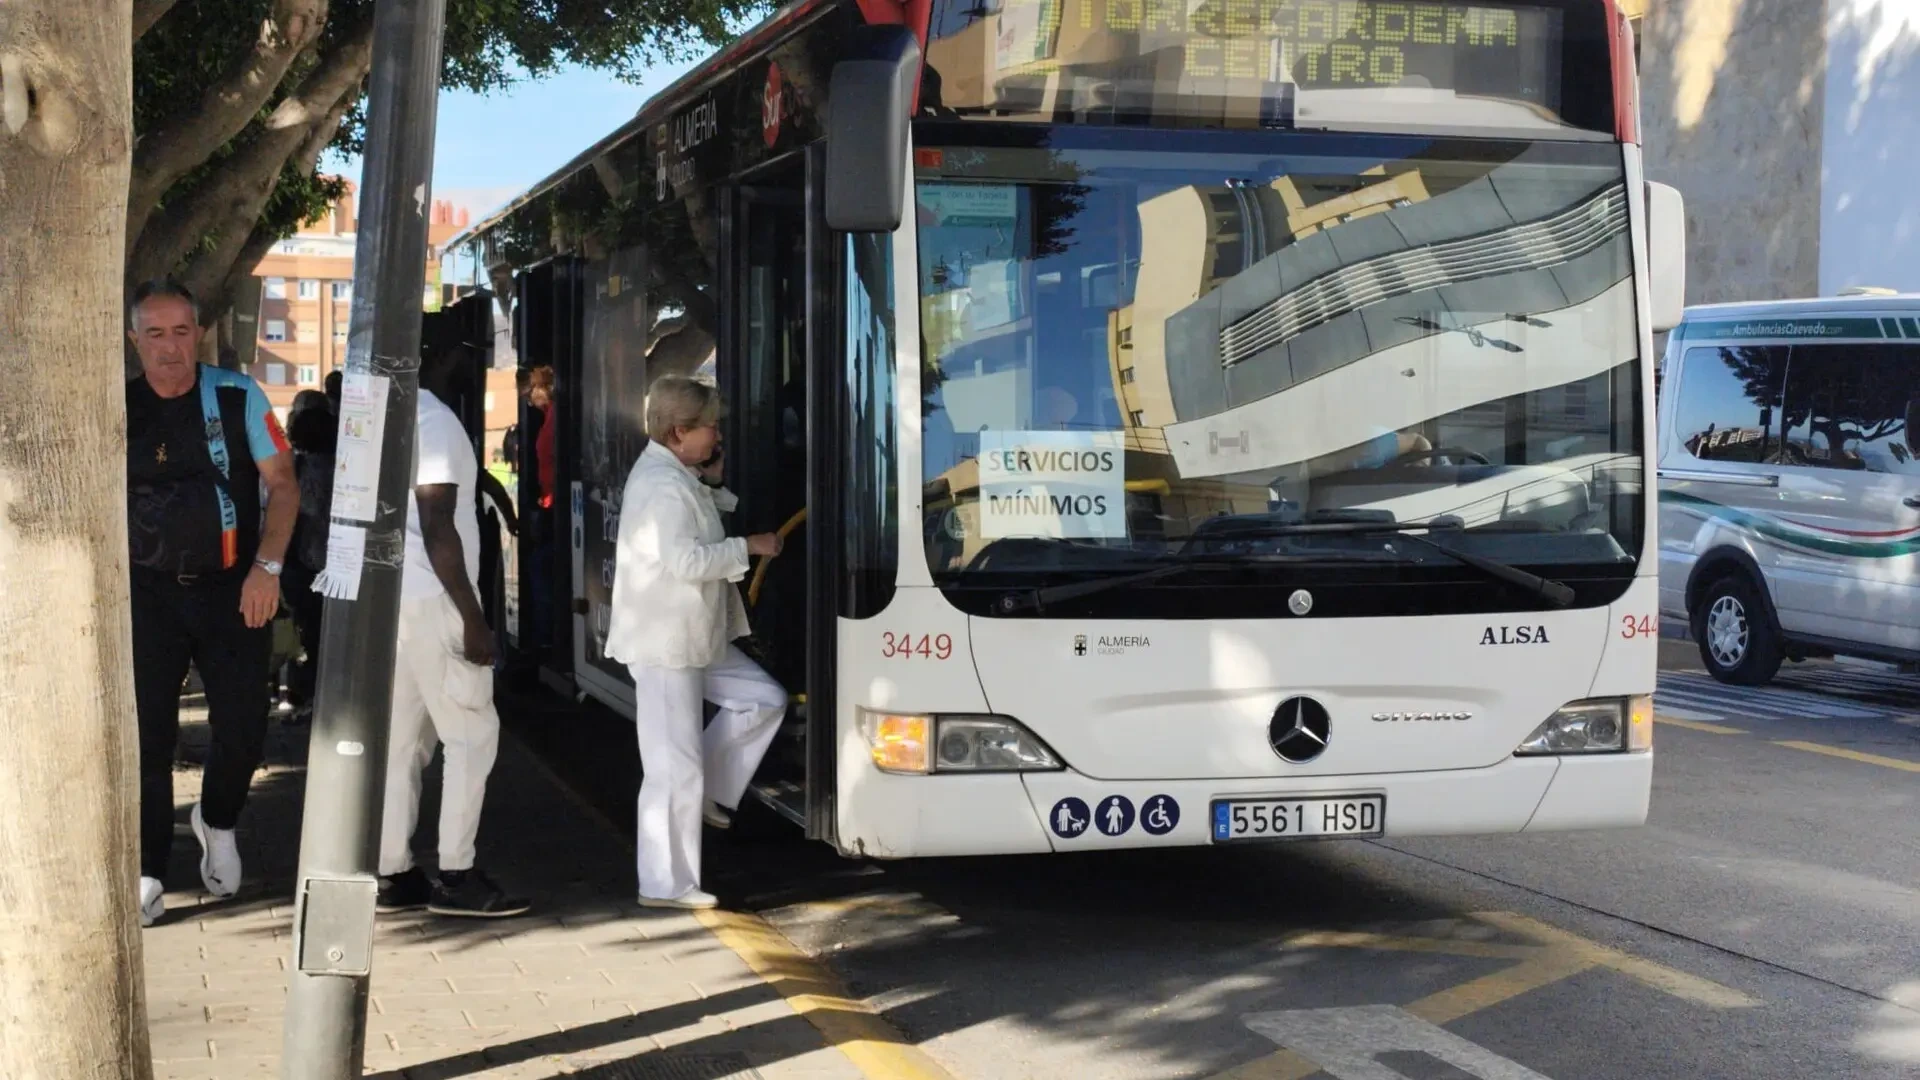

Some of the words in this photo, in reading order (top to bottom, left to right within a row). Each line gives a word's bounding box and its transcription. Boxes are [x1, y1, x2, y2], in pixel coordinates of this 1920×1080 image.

[1185, 38, 1405, 84] CENTRO
[674, 89, 718, 155] ALMERÍA
[989, 450, 1113, 472] SERVICIOS
[989, 489, 1107, 516] MÍNIMOS
[882, 631, 953, 660] 3449
[1097, 633, 1151, 648] ALMERÍA
[1479, 625, 1551, 645] ALSA
[1219, 824, 1227, 833] E
[1232, 805, 1304, 834] 5561
[1322, 802, 1376, 832] HSD
